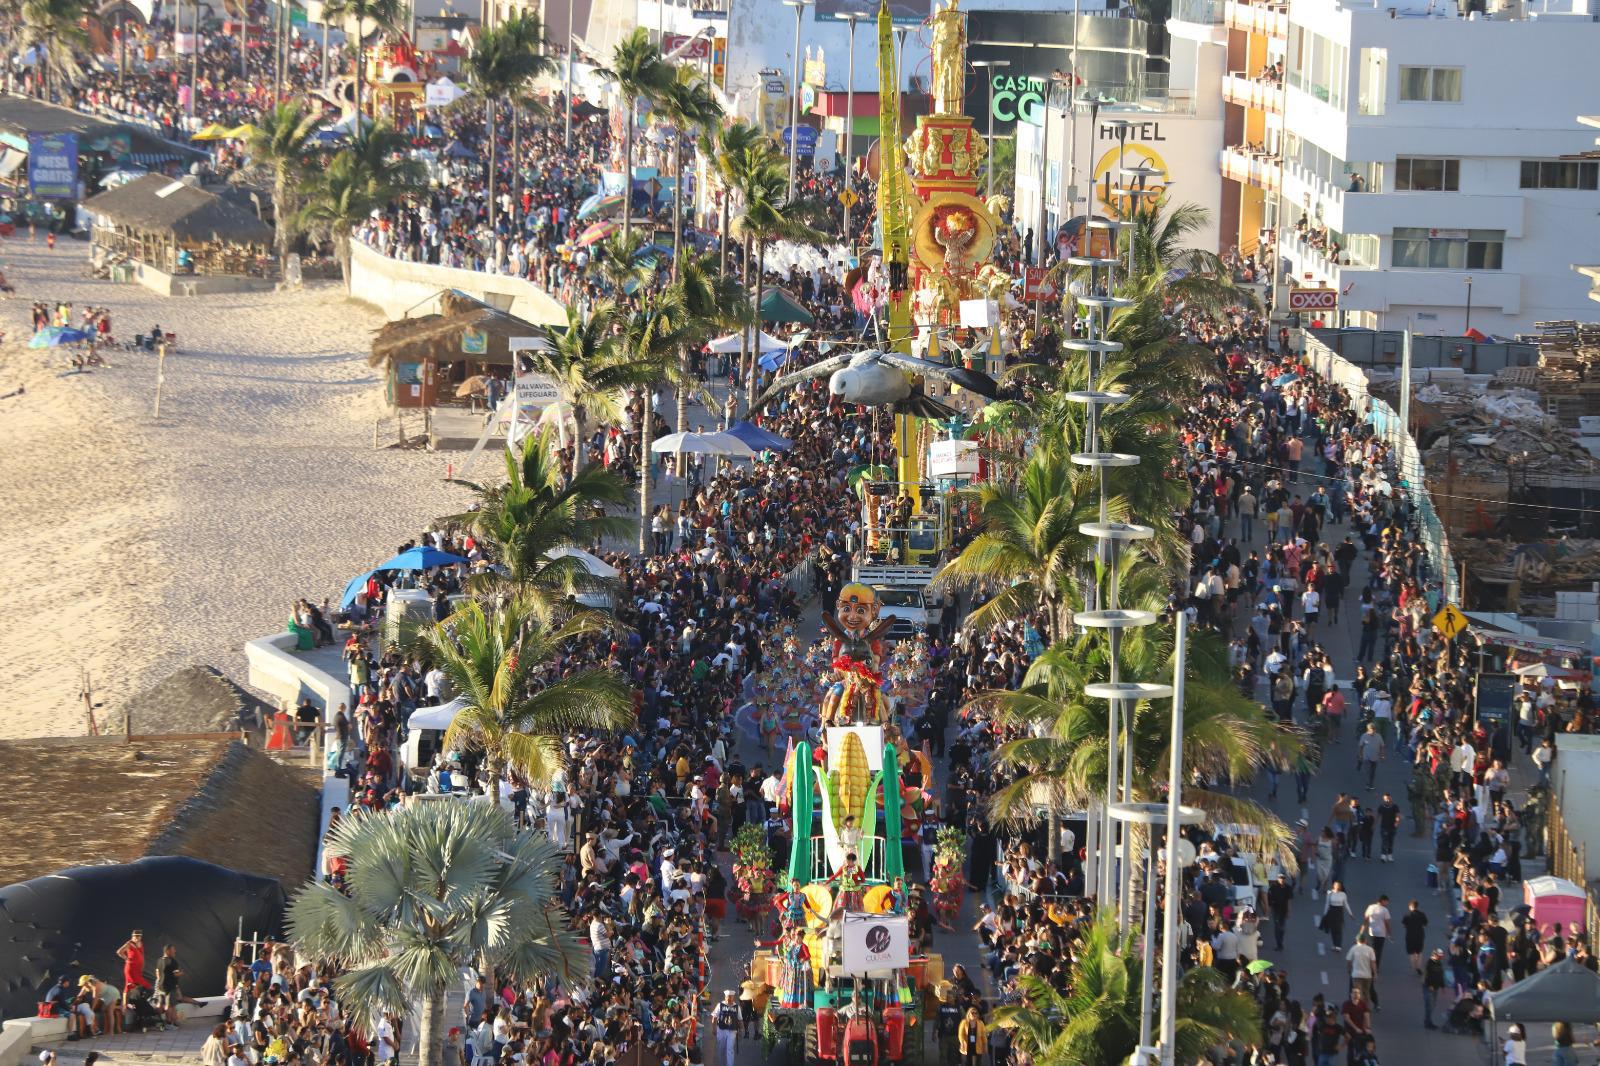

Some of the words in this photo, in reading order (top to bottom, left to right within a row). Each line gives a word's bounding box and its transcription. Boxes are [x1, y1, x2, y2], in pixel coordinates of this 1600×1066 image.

[37, 156, 69, 169] MESA
[33, 169, 73, 183] GRATIS
[1292, 293, 1335, 307] OXXO
